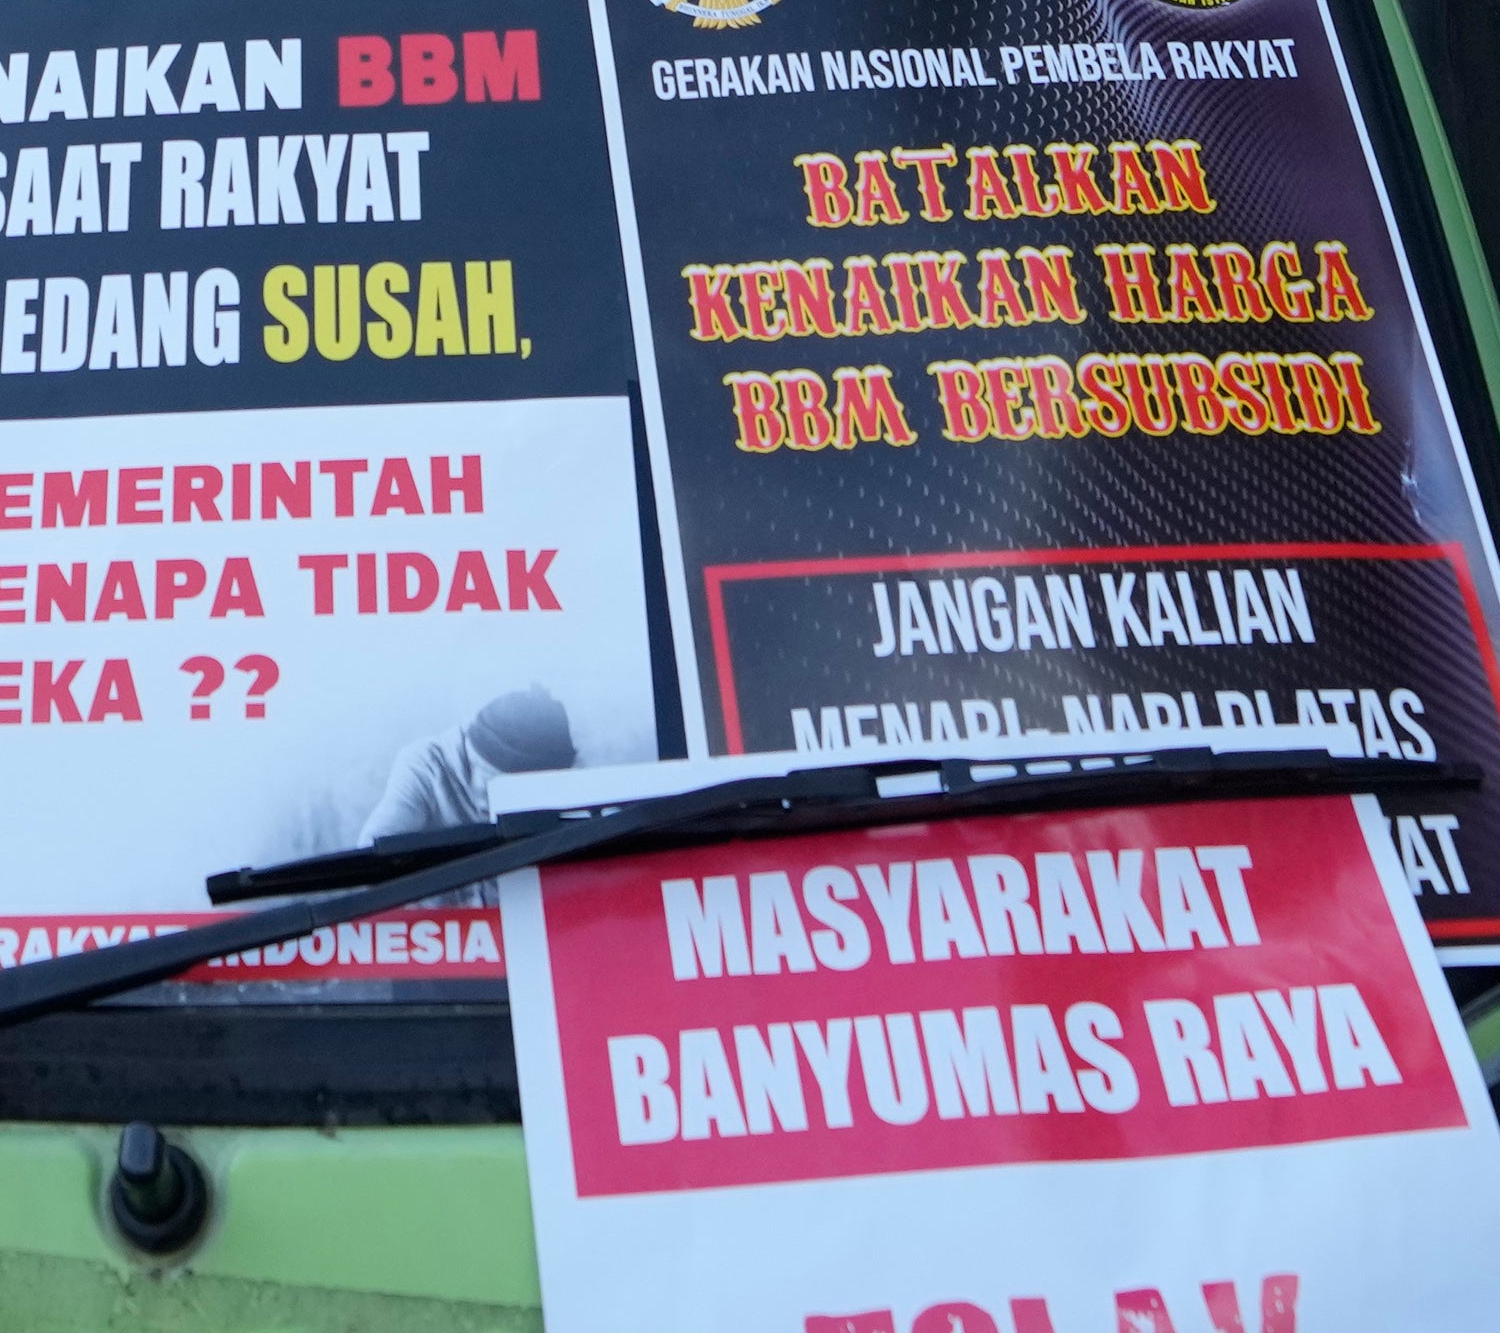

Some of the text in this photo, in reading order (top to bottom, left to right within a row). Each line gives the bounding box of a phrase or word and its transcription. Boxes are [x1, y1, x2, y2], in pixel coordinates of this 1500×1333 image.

[337, 29, 542, 108] BBM
[652, 37, 1299, 102] GERAKAN NASIONAL PEMBELA RAKYAT
[160, 130, 429, 229] RAKYAT
[793, 139, 1216, 229] BATALKAN
[263, 259, 533, 363] SUSAH,
[681, 240, 1374, 343] KENAIKAN HARGA
[723, 350, 1382, 454] BBM BERSUBSIDI
[299, 548, 563, 615] TIDAK
[871, 567, 1315, 658] JANGAN KALIAN
[178, 653, 281, 721] ??
[207, 918, 501, 968] DONESIA
[660, 845, 1261, 981] MASYARAKAT
[607, 983, 1403, 1147] BANYUMAS RAYA
